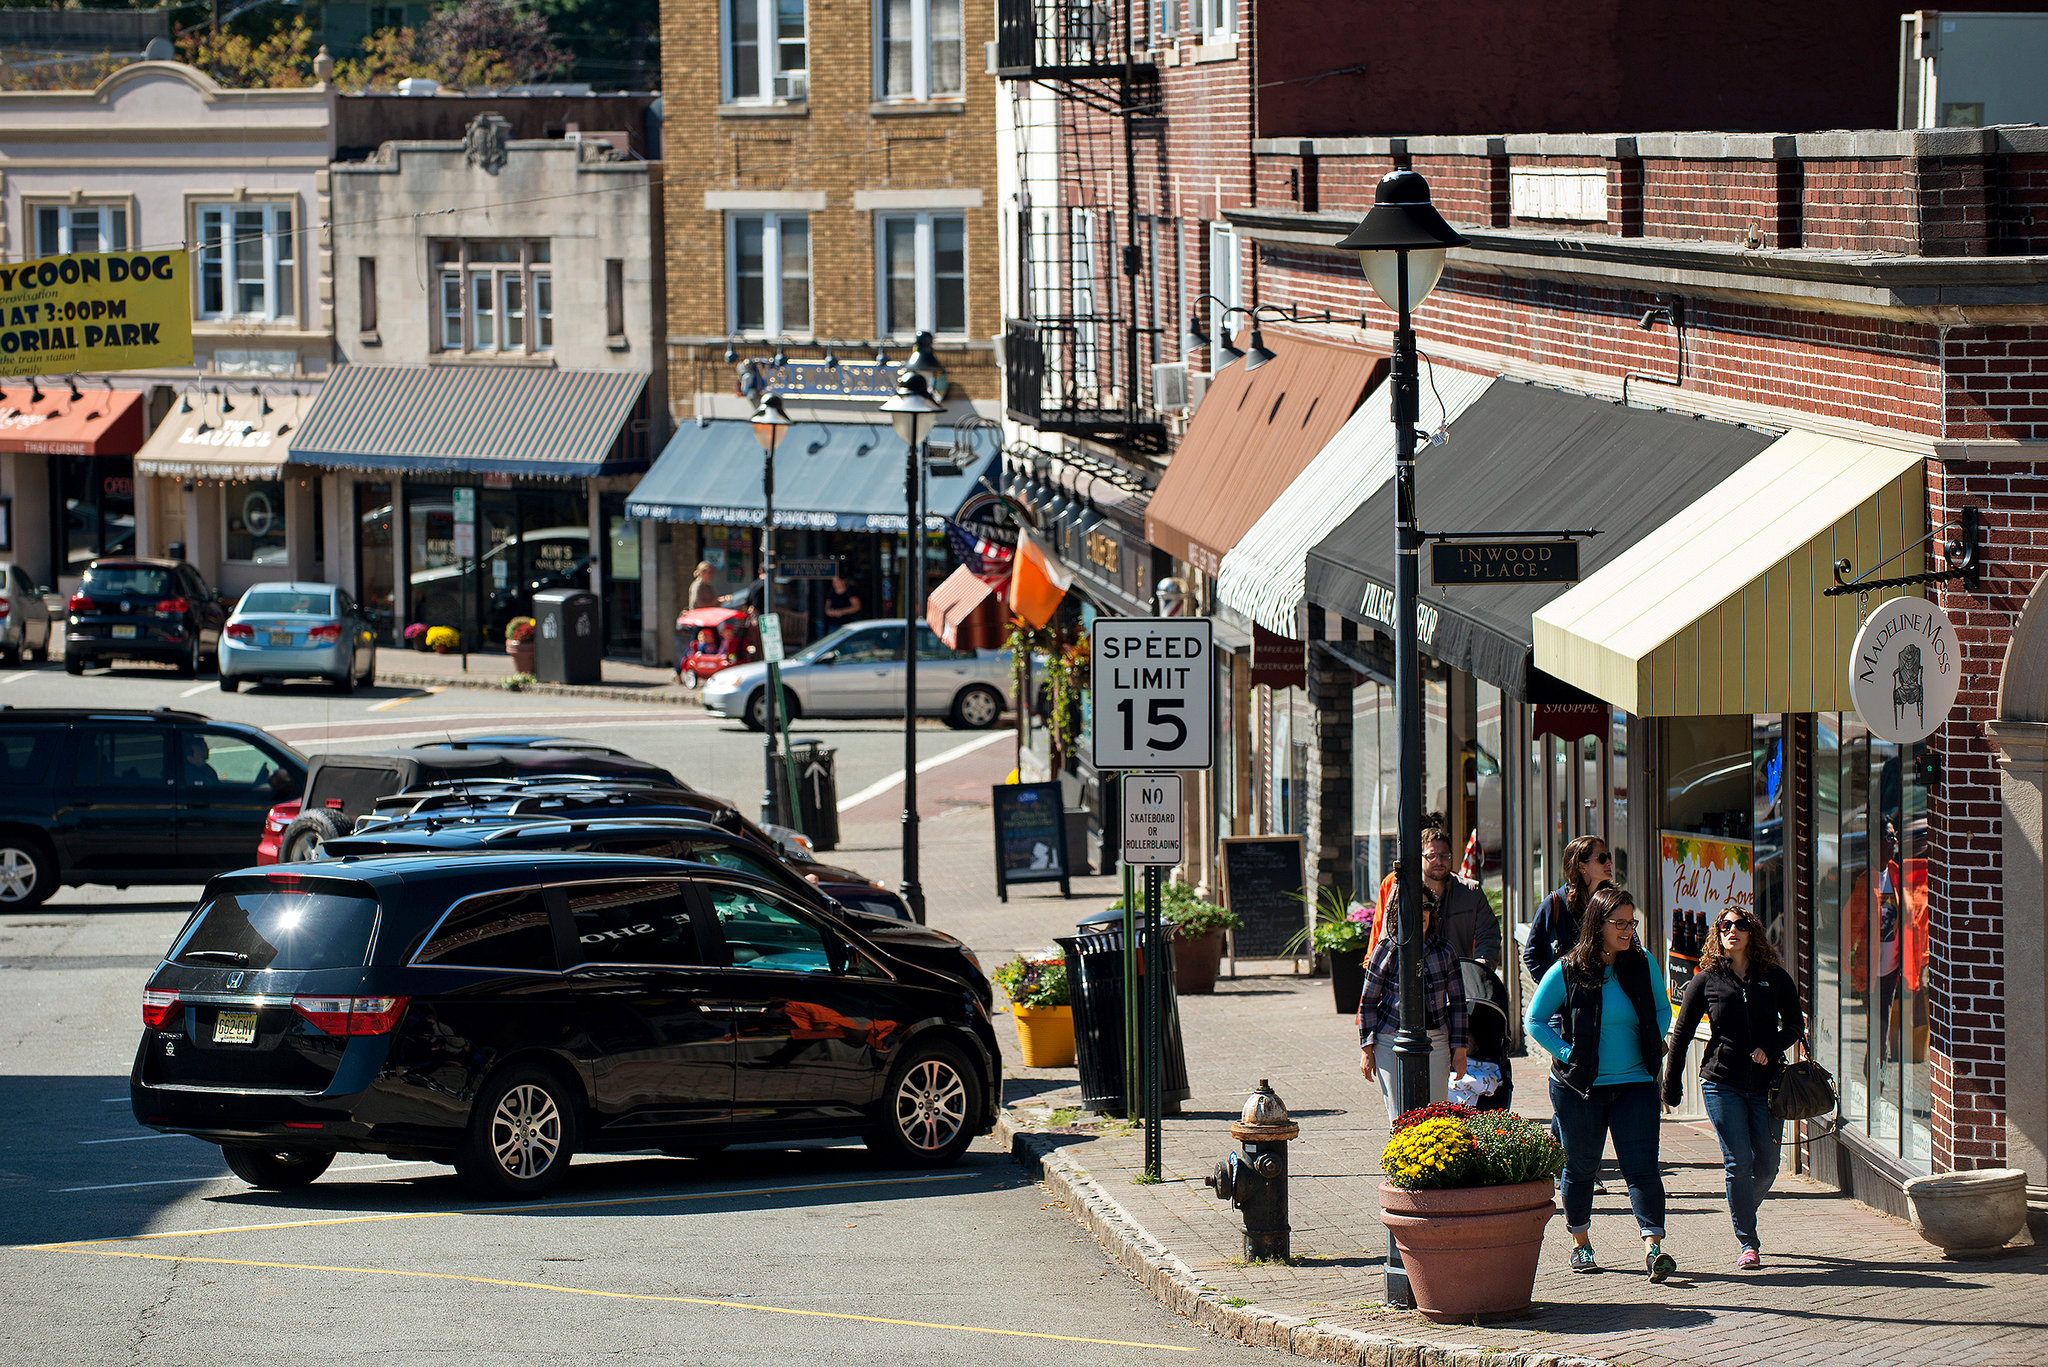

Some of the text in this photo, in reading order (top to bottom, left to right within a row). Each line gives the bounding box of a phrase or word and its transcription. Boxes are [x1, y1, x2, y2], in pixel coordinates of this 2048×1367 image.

[107, 255, 173, 283] DOG
[11, 304, 39, 326] AT
[44, 299, 127, 322] 3:00PM
[84, 322, 160, 348] PARK
[223, 420, 253, 431] THE
[178, 428, 271, 447] LAUREL
[1458, 547, 1552, 563] INWOOD
[1473, 563, 1538, 578] PLACE
[1360, 582, 1393, 626] VILLAGE
[1417, 602, 1438, 645] SHOP
[1103, 636, 1202, 659] SPEED
[1859, 613, 1950, 684] MADELINE MOSS
[1114, 667, 1191, 690] LIMIT
[1117, 698, 1187, 751] 15
[1142, 788, 1163, 805] NO
[1130, 813, 1175, 824] SKATEBOARD
[1148, 826, 1158, 836] OR
[1126, 839, 1179, 850] ROLLERBLADING
[1673, 863, 1699, 904] Fall
[1702, 869, 1720, 904] In
